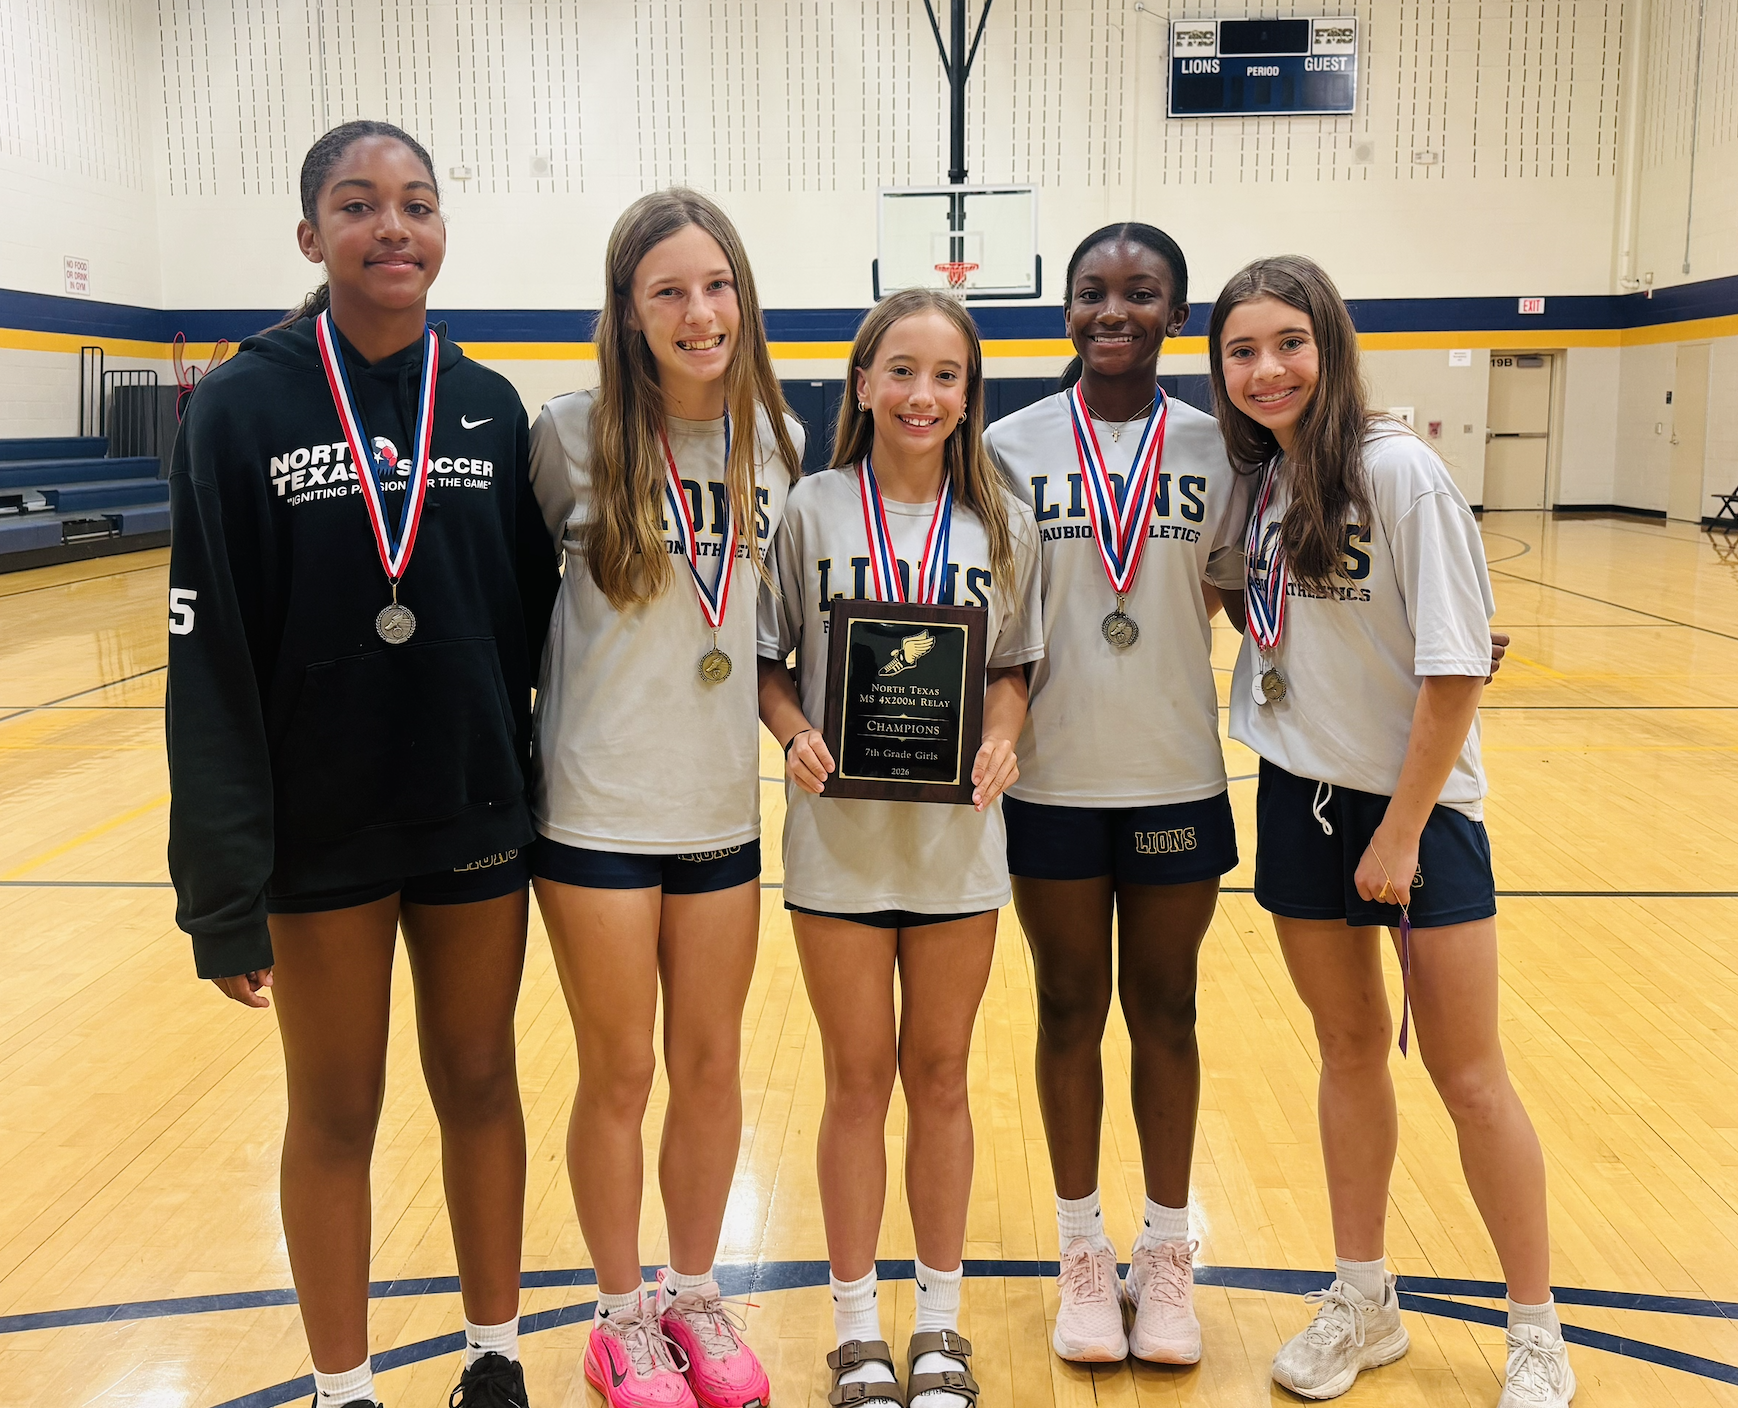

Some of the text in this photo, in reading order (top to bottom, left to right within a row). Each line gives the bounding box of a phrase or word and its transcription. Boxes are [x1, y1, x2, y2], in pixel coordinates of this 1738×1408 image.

[1181, 59, 1220, 74] LIONS
[1304, 57, 1347, 72] GUEST
[1246, 66, 1280, 77] PERIOD
[66, 260, 87, 271] NO FOOD
[66, 270, 88, 281] OR DRINK
[70, 281, 86, 291] IN GYM
[1523, 299, 1541, 312] EXIT
[1490, 358, 1513, 368] 19B
[270, 441, 352, 478] NORT
[351, 481, 407, 495] PSION
[438, 477, 461, 488] THE
[1040, 525, 1201, 544] AUBIO LETICS
[169, 587, 198, 636] 5
[860, 693, 875, 703] MS
[865, 748, 938, 761] 7th Grade Girls
[891, 767, 910, 776] 2026
[1134, 826, 1198, 854] LIONS
[453, 848, 519, 872] ONS
